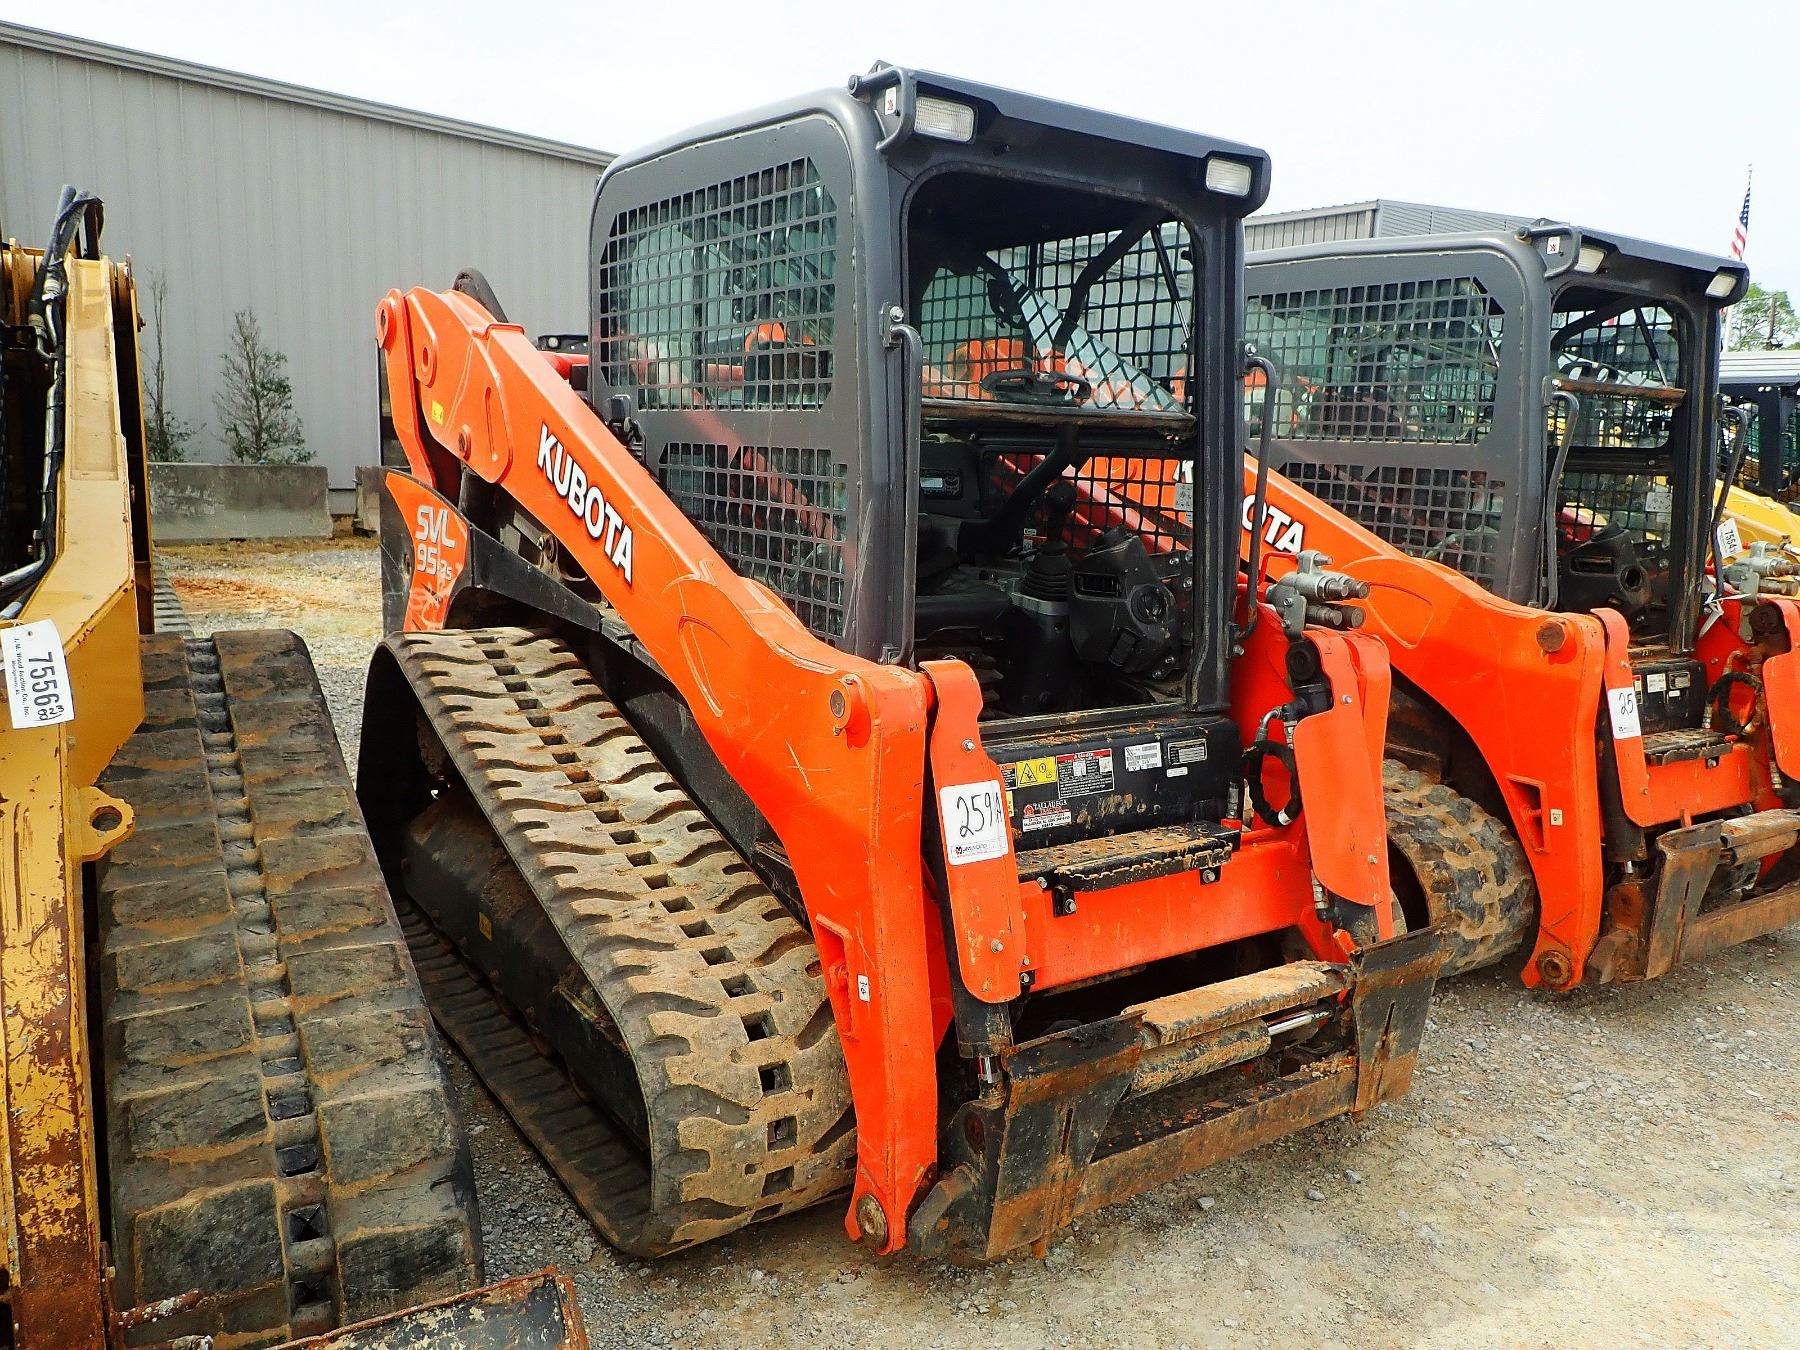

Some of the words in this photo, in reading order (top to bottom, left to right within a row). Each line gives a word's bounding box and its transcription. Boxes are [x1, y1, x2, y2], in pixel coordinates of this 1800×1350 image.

[415, 504, 456, 549] SVL
[537, 423, 633, 585] KUBOTA
[28, 651, 60, 707] 7556
